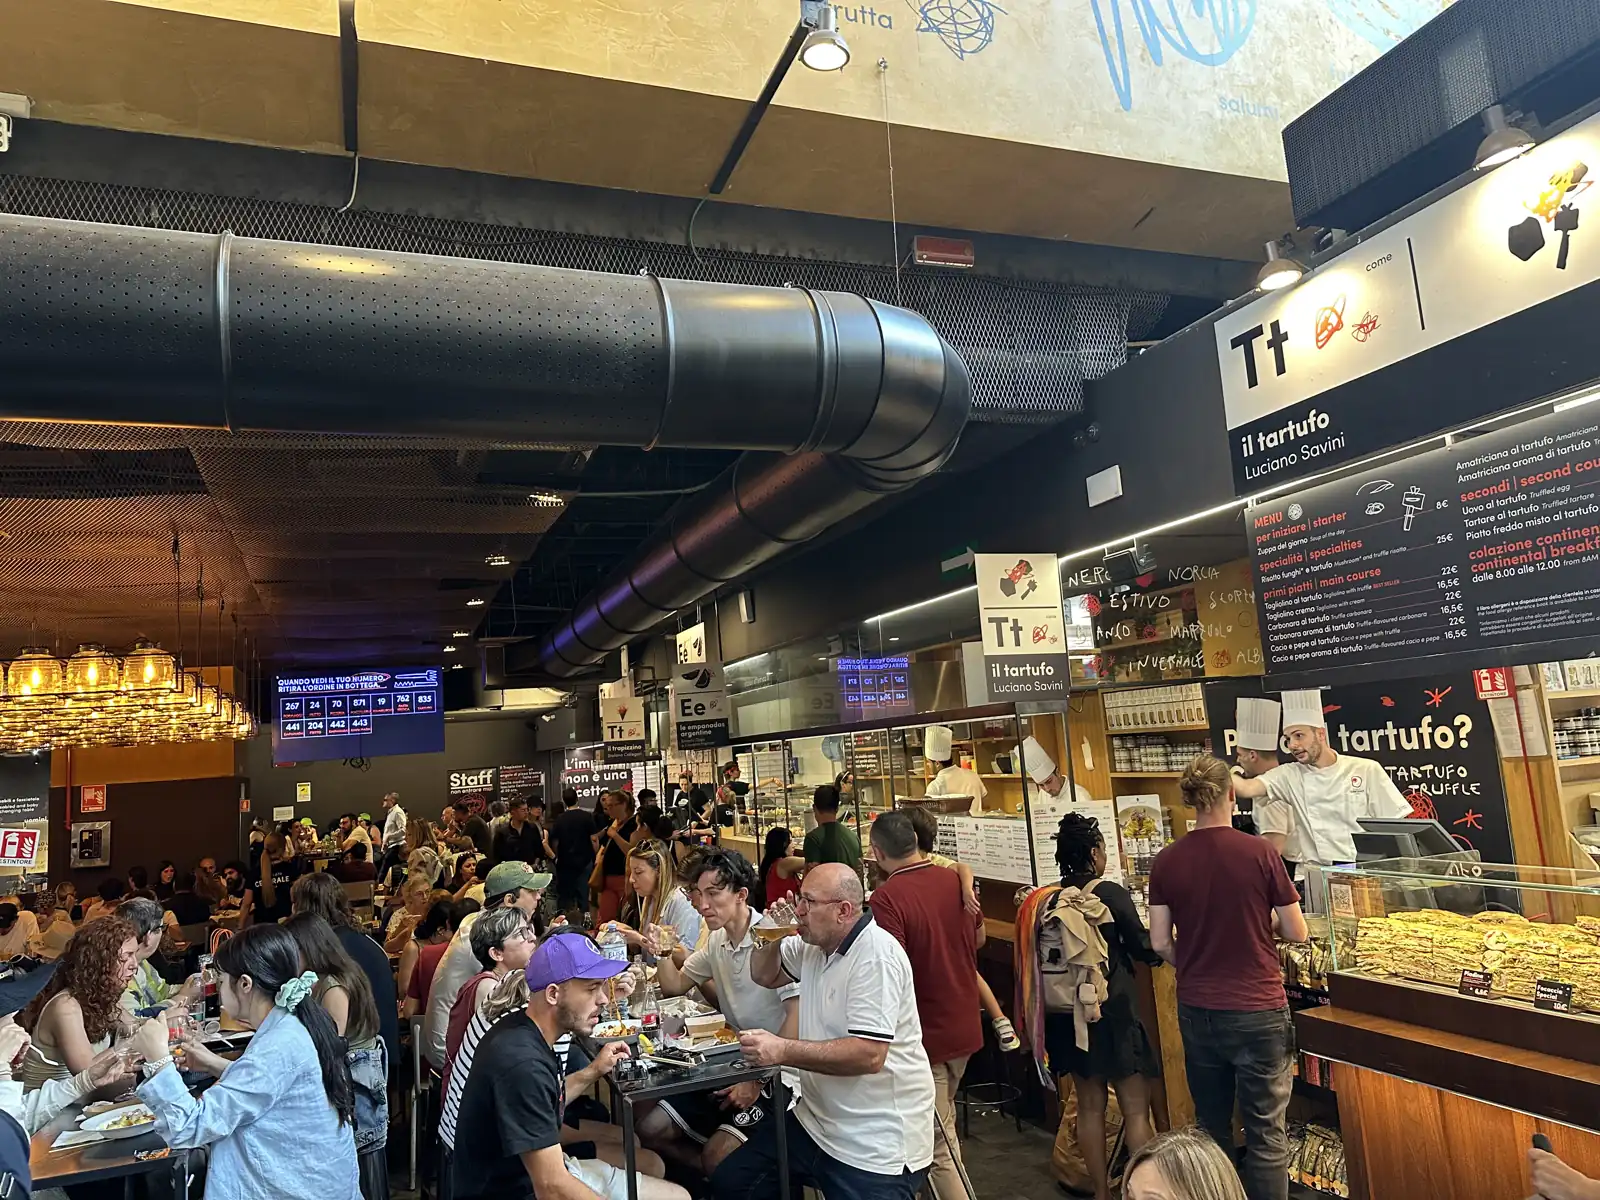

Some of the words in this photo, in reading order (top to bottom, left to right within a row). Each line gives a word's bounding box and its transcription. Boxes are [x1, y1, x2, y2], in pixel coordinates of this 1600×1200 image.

[1366, 252, 1393, 272] come
[1230, 319, 1289, 389] Tt
[1242, 435, 1254, 458] il
[1258, 409, 1330, 452] tartufo
[1245, 454, 1297, 480] Luciano
[1301, 432, 1345, 461] Savini
[1456, 450, 1508, 470] Amatriciana
[1511, 445, 1519, 455] al
[1521, 436, 1553, 451] tartufo
[1556, 425, 1599, 442] Amatriciana
[1458, 463, 1510, 483] Amatriciana
[1512, 455, 1543, 468] aroma
[1546, 449, 1555, 458] di
[1557, 440, 1591, 455] tartufo
[1460, 479, 1510, 502] secondi
[1520, 462, 1571, 487] second
[1436, 500, 1448, 510] 8€
[1462, 504, 1484, 515] Uovo
[1486, 500, 1494, 509] al
[1496, 492, 1527, 507] tartufo
[1529, 486, 1555, 499] Truffled
[1557, 484, 1570, 493] egg
[1464, 515, 1495, 528] Tartare
[1498, 511, 1505, 520] al
[1508, 504, 1539, 517] tartufo
[1542, 499, 1568, 510] Truffled
[1570, 493, 1594, 504] tartare
[1254, 512, 1283, 529] MENU
[1256, 534, 1271, 544] per
[1272, 523, 1306, 539] iniziare
[1313, 511, 1347, 528] starter
[1466, 530, 1491, 540] Piatto
[1493, 522, 1523, 535] freddo
[1526, 515, 1550, 528] misto
[1553, 511, 1562, 521] al
[1564, 504, 1599, 518] tartufo
[1258, 545, 1276, 555] Zuppa
[1277, 542, 1287, 550] del
[1288, 537, 1308, 549] giorno
[1436, 533, 1454, 543] 25€
[1260, 551, 1303, 572] specialità
[1310, 540, 1363, 560] specialties
[1469, 540, 1533, 560] colazione
[1471, 546, 1546, 573] continental
[1472, 572, 1493, 583] dalle
[1496, 568, 1515, 579] 8.00
[1518, 564, 1534, 574] alle
[1536, 559, 1560, 571] 12.00
[1582, 554, 1599, 563] 8AM
[1168, 565, 1220, 582] NORCIA
[1261, 573, 1281, 583] Risotto
[1311, 562, 1333, 573] tartufo
[1441, 565, 1458, 576] 22€
[1263, 587, 1286, 600] primi
[1288, 582, 1313, 596] piatti
[1320, 575, 1344, 588] main
[1346, 568, 1381, 582] course
[1437, 578, 1460, 590] 16,5€
[1110, 592, 1170, 611] ESTIVO
[1264, 598, 1293, 611] Tagliolino
[1301, 593, 1322, 603] tartufo
[1445, 591, 1461, 601] 22€
[1266, 609, 1294, 621] Tagliolino
[1295, 606, 1315, 614] crema
[1440, 604, 1464, 615] 16,5€
[1268, 619, 1300, 630] Carbonara
[1308, 613, 1330, 624] tartufo
[1448, 616, 1465, 626] 22€
[988, 617, 1023, 647] Tt
[1269, 630, 1302, 642] Carbonara
[1303, 627, 1323, 636] aroma
[1332, 621, 1355, 632] tartufo
[1444, 628, 1468, 640] 16,5€
[1271, 642, 1288, 652] Cacio
[1294, 638, 1309, 649] pepe
[1311, 637, 1317, 646] al
[1318, 635, 1340, 645] tartufo
[1129, 650, 1206, 672] INVERNALE
[1272, 653, 1289, 663] Cacio
[1295, 650, 1310, 661] pepe
[1311, 648, 1332, 658] aroma
[1333, 646, 1339, 654] di
[1340, 643, 1363, 654] tartufo
[992, 663, 1000, 677] il
[1004, 662, 1054, 677] tartufo
[993, 682, 1032, 692] Luciano
[1034, 680, 1063, 691] Savini
[681, 698, 706, 717] Ee
[308, 722, 323, 730] 204
[607, 726, 624, 738] Tt
[1338, 714, 1472, 753] tartufo?
[450, 770, 492, 787] Staff
[566, 774, 588, 784] non
[593, 771, 600, 781] è
[604, 771, 627, 780] una
[1408, 783, 1481, 796] TRUFFLE
[255, 876, 289, 888] CERALE
[1537, 985, 1563, 994] Focaccia
[1537, 991, 1557, 1000] Special
